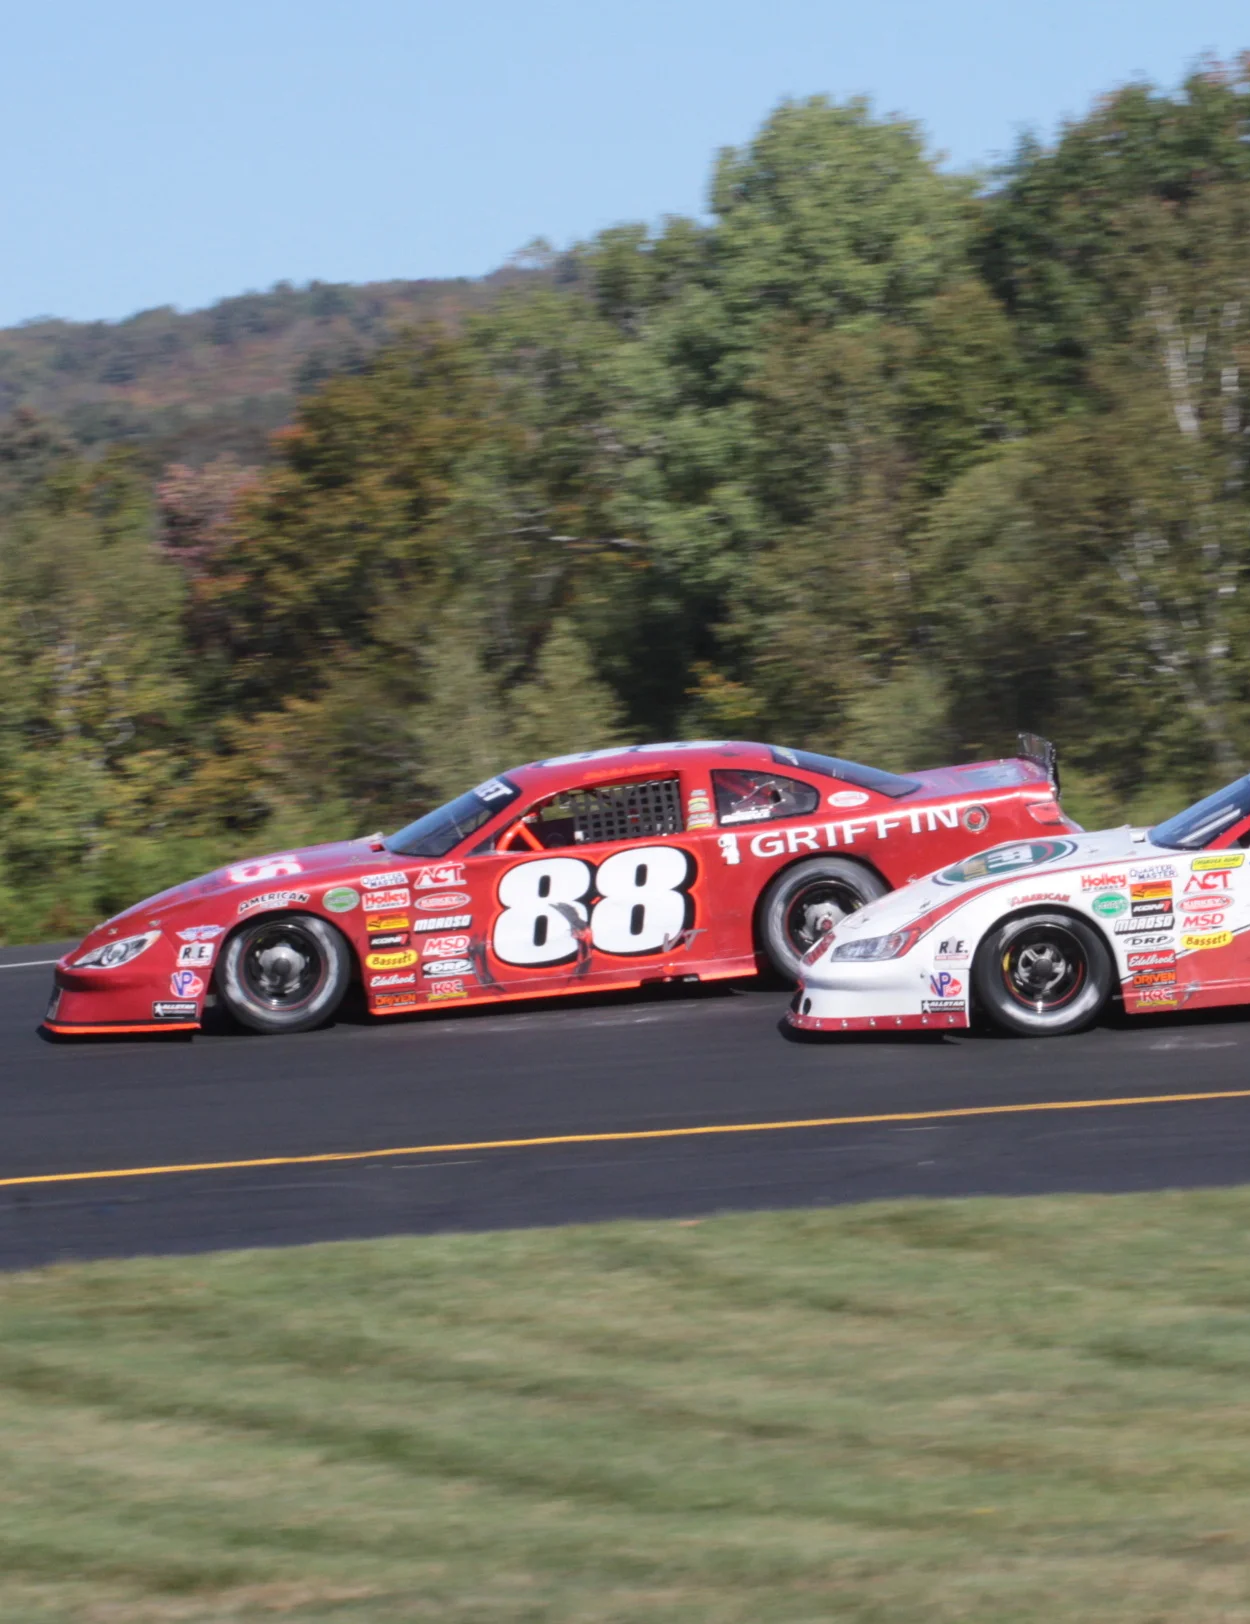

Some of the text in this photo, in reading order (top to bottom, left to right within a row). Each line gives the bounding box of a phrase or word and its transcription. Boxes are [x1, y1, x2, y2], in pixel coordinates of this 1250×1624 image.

[750, 807, 959, 857] GRIFFIN
[415, 863, 466, 887] ACT
[1081, 873, 1127, 888] Holley
[1184, 870, 1232, 892] ACT
[239, 891, 310, 913] AMERICAN
[365, 889, 408, 905] Holley
[1011, 893, 1071, 907] AMERICAN
[493, 845, 699, 968] 88
[414, 915, 472, 932] MOROSO
[1115, 915, 1175, 934] MOROSO
[1183, 913, 1225, 928] MSD
[423, 935, 470, 955] MSD
[662, 928, 707, 952] VT
[1131, 935, 1168, 946] DRP
[1185, 932, 1227, 946] Bassett
[371, 950, 412, 966] Bassett
[1128, 952, 1176, 967] Edelbrock
[172, 971, 194, 996] VP
[930, 971, 951, 997] VP
[1133, 971, 1176, 985] DRIVEN
[376, 994, 416, 1006] DRIVEN
